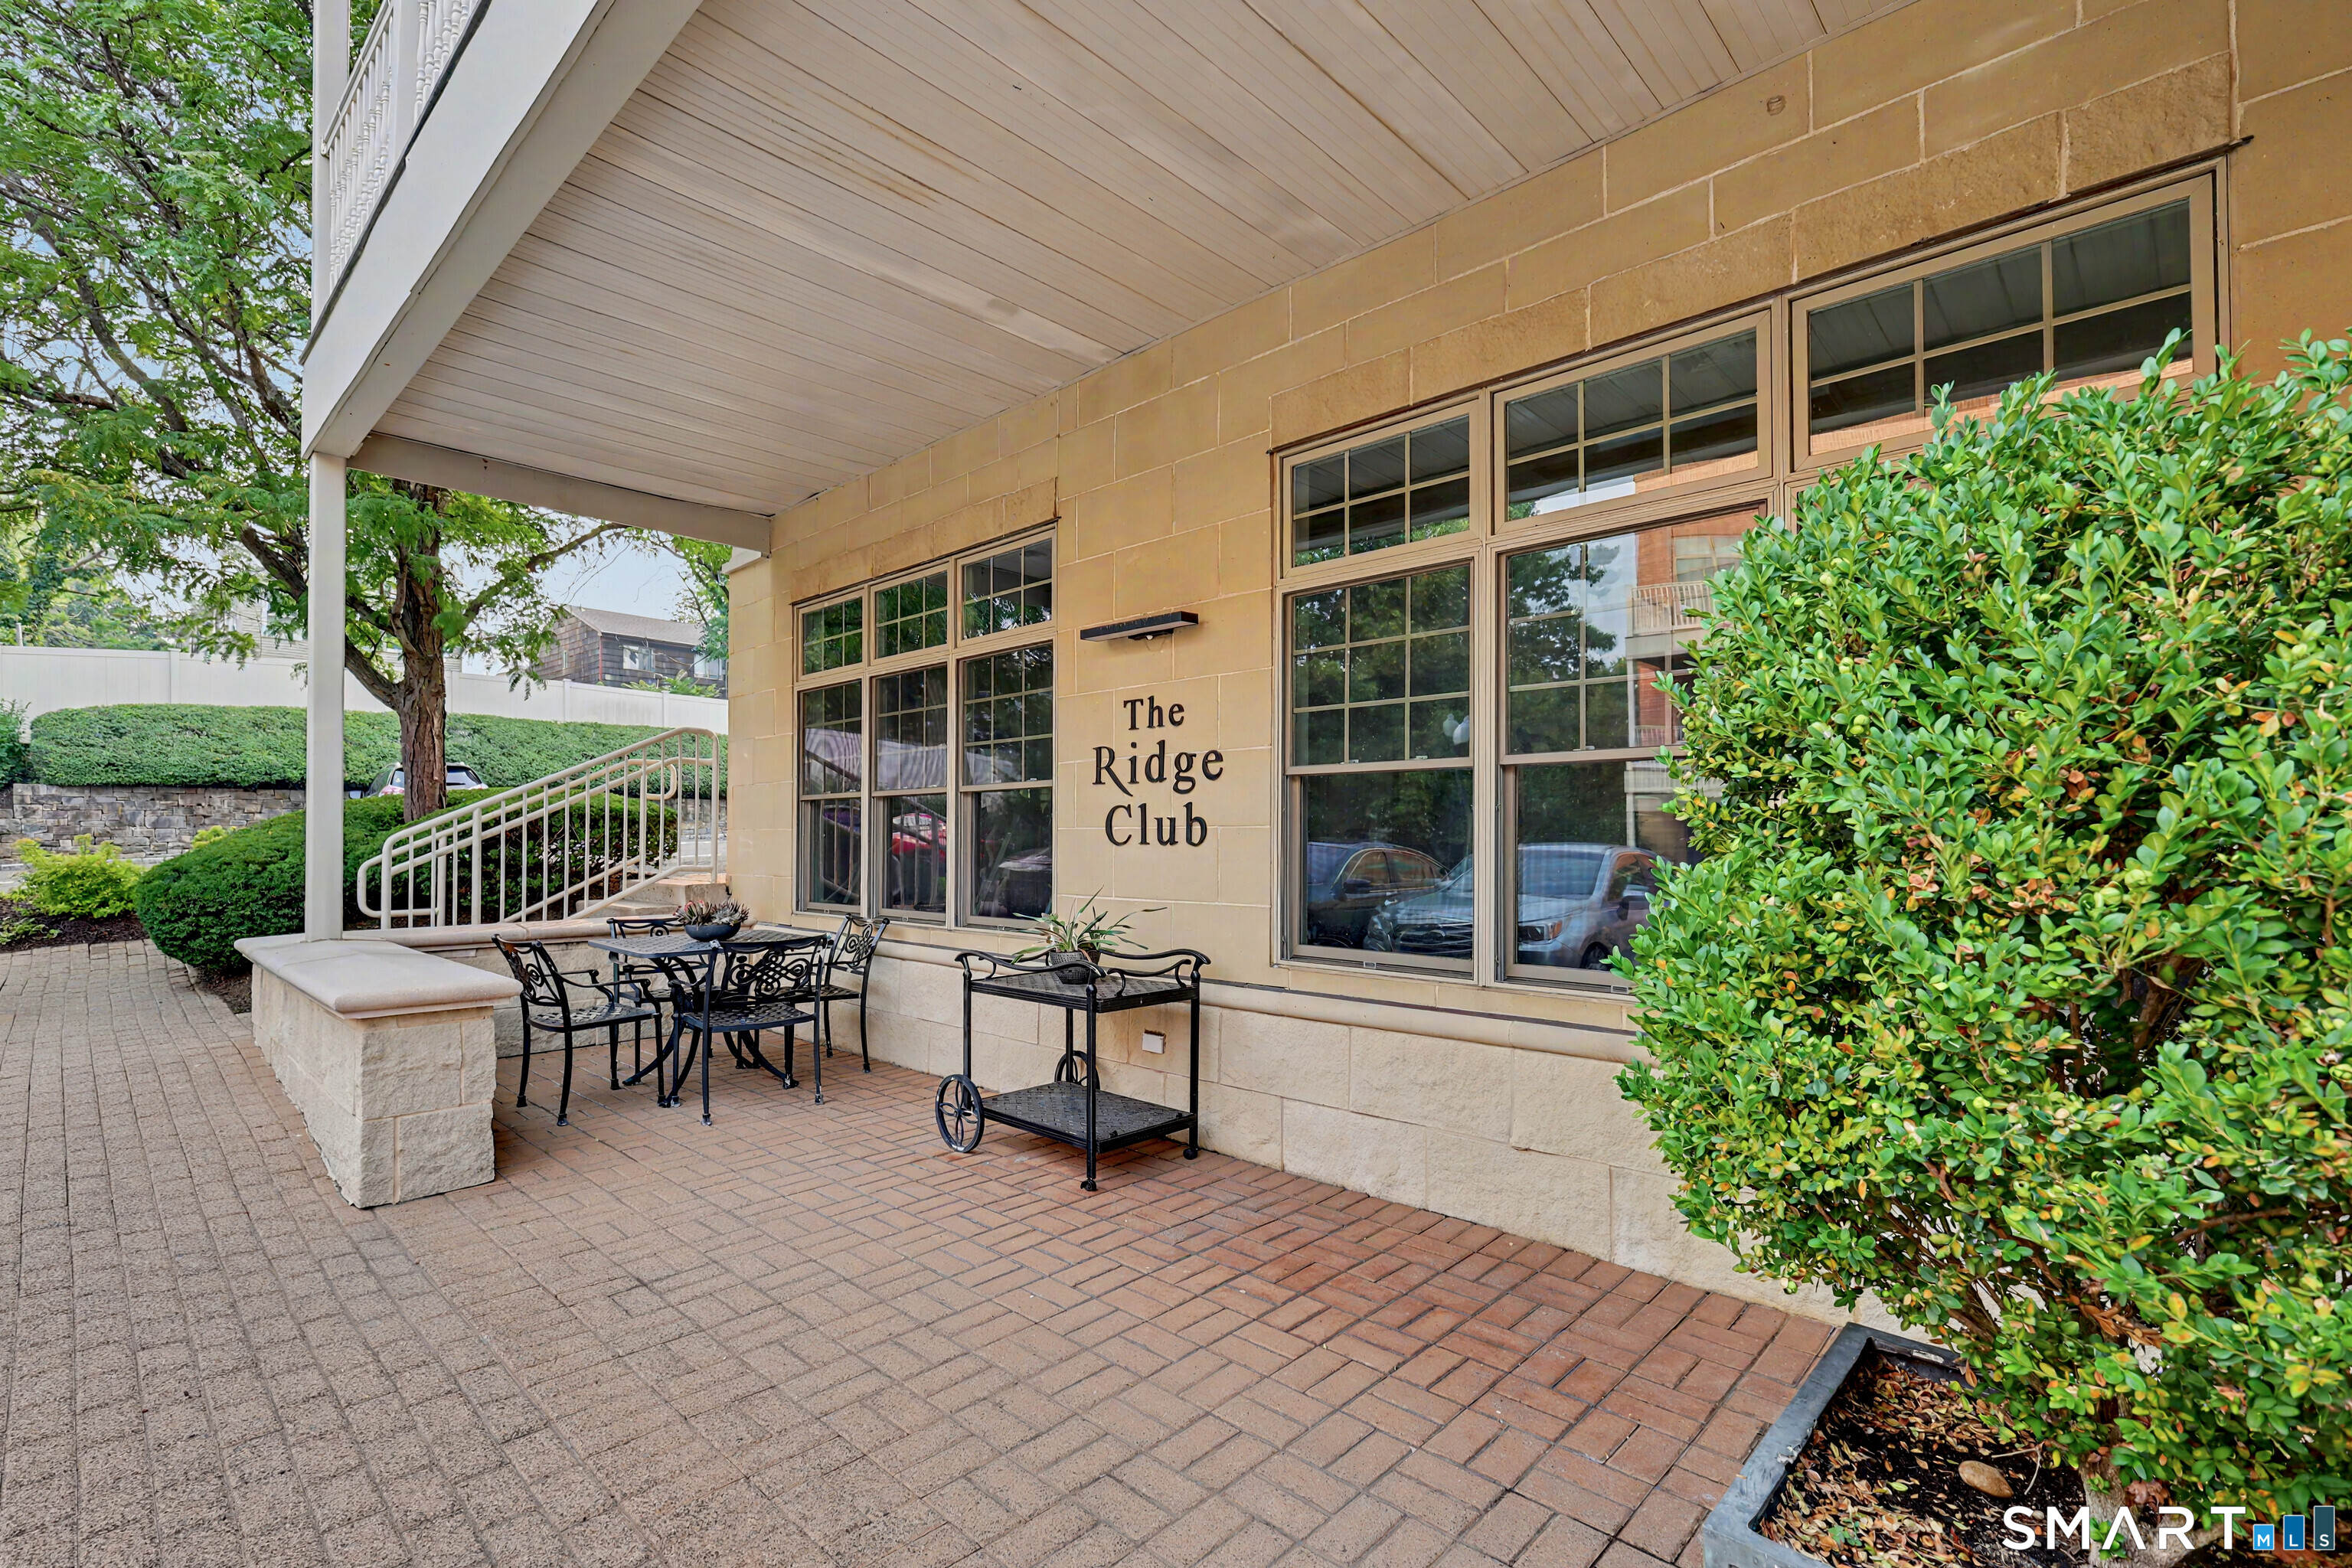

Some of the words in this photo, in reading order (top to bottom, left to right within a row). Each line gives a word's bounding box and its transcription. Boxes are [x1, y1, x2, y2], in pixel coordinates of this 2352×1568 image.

[1123, 695, 1184, 730] The
[1092, 740, 1224, 796] Ridge
[1105, 802, 1207, 847] Club
